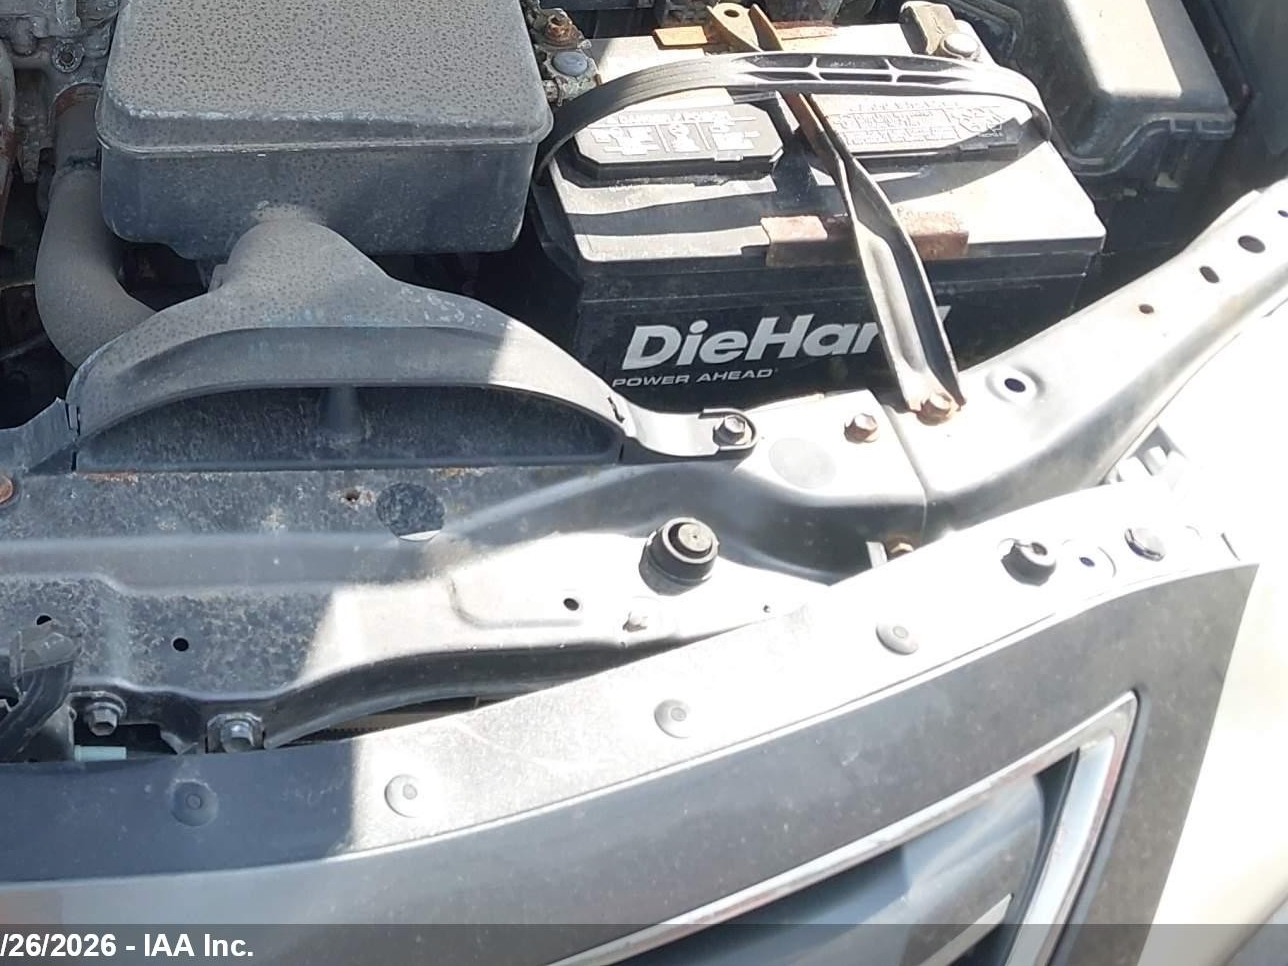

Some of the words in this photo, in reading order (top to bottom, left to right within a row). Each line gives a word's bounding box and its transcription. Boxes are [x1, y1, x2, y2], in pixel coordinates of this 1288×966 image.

[621, 305, 951, 371] DieHar
[612, 373, 690, 388] POWER
[696, 368, 774, 384] AHEAD
